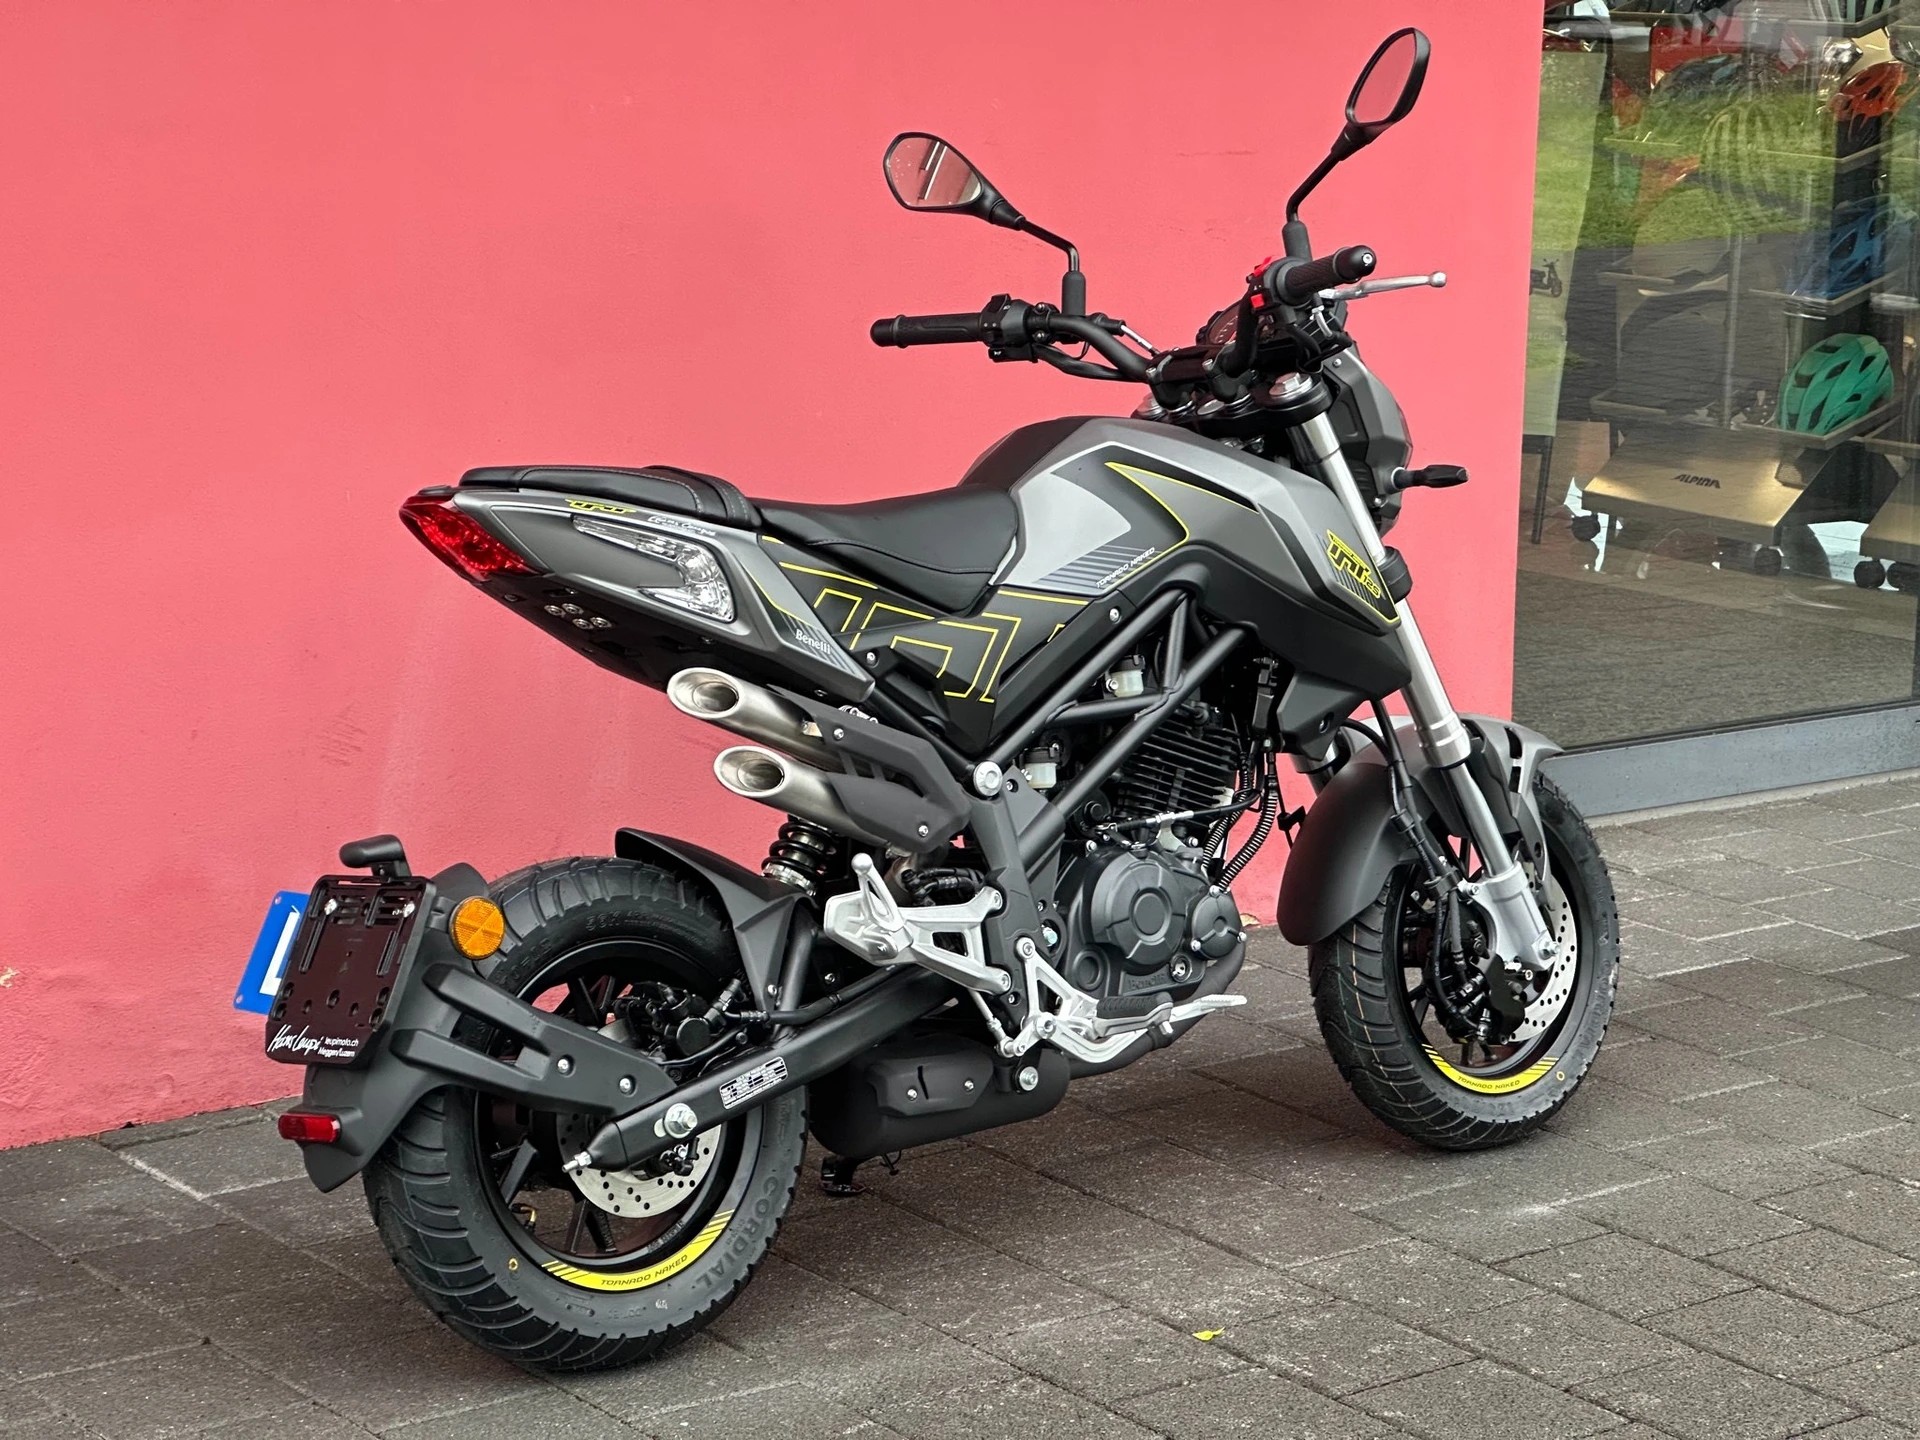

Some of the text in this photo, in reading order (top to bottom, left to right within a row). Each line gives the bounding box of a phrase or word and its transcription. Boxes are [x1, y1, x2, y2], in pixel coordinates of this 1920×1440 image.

[1673, 474, 1721, 489] ALPINA
[1096, 546, 1155, 588] TORNADO NAKED
[795, 628, 831, 655] Benelli
[1457, 1075, 1521, 1090] TORNADO NAKED
[697, 1176, 780, 1288] CORDIAL
[601, 1254, 688, 1286] TORNADO NAKED
